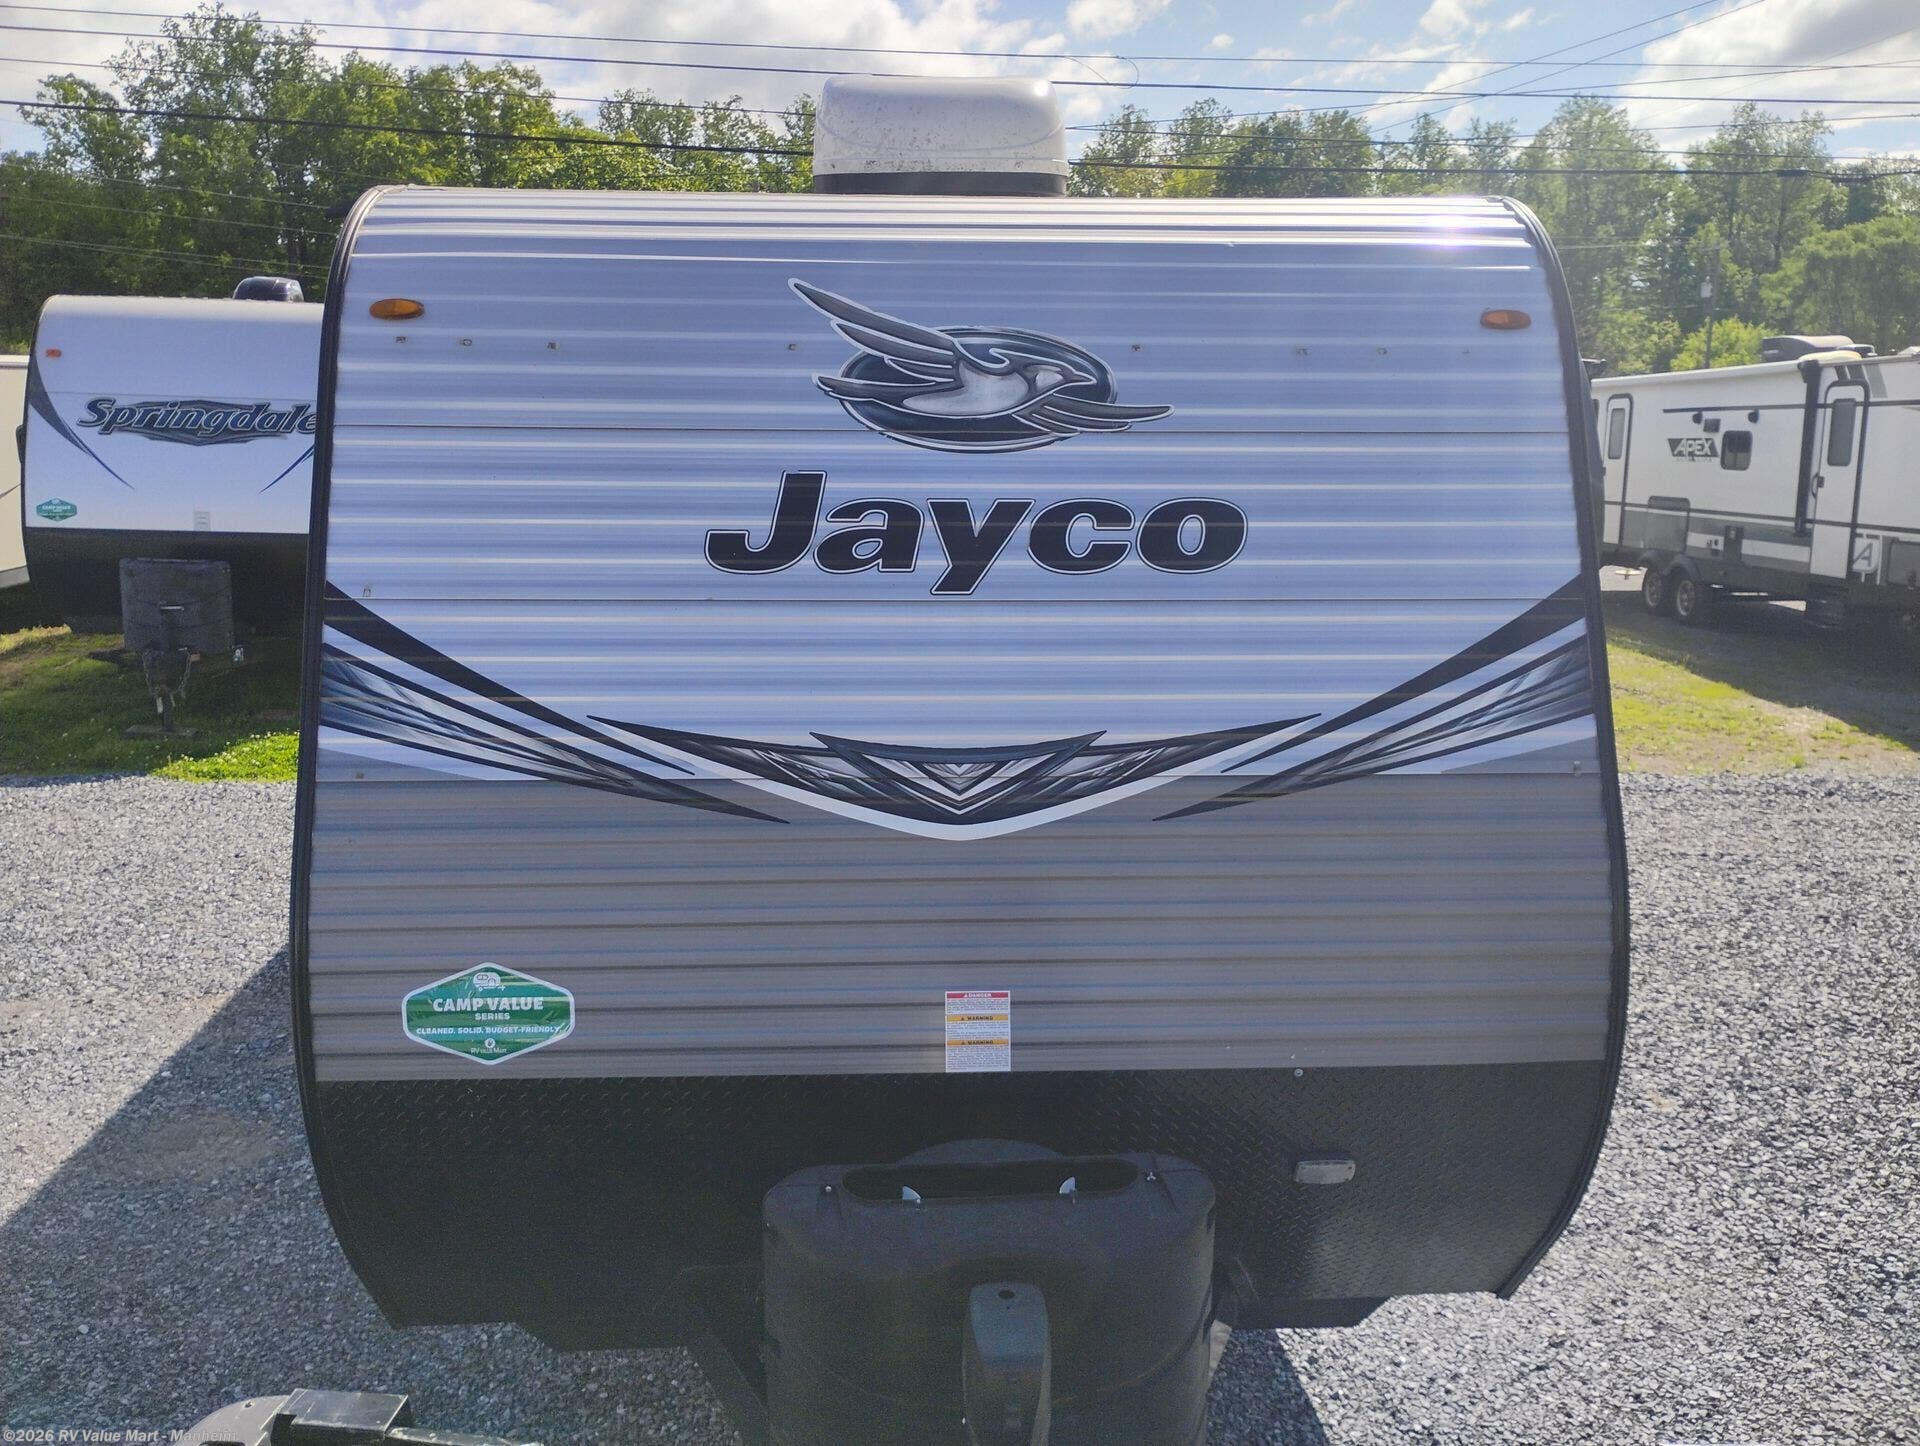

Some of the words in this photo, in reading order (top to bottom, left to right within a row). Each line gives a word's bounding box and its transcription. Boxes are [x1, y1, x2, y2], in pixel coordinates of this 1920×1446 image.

[76, 397, 316, 436] Springdale
[1674, 438, 1713, 455] APEX
[704, 470, 1248, 596] Jayco
[433, 998, 483, 1012] CAMP
[487, 997, 544, 1011] VALUE
[475, 1012, 510, 1021] SERIES
[416, 1026, 456, 1035] CLEANED.
[457, 1026, 484, 1034] SOLID.
